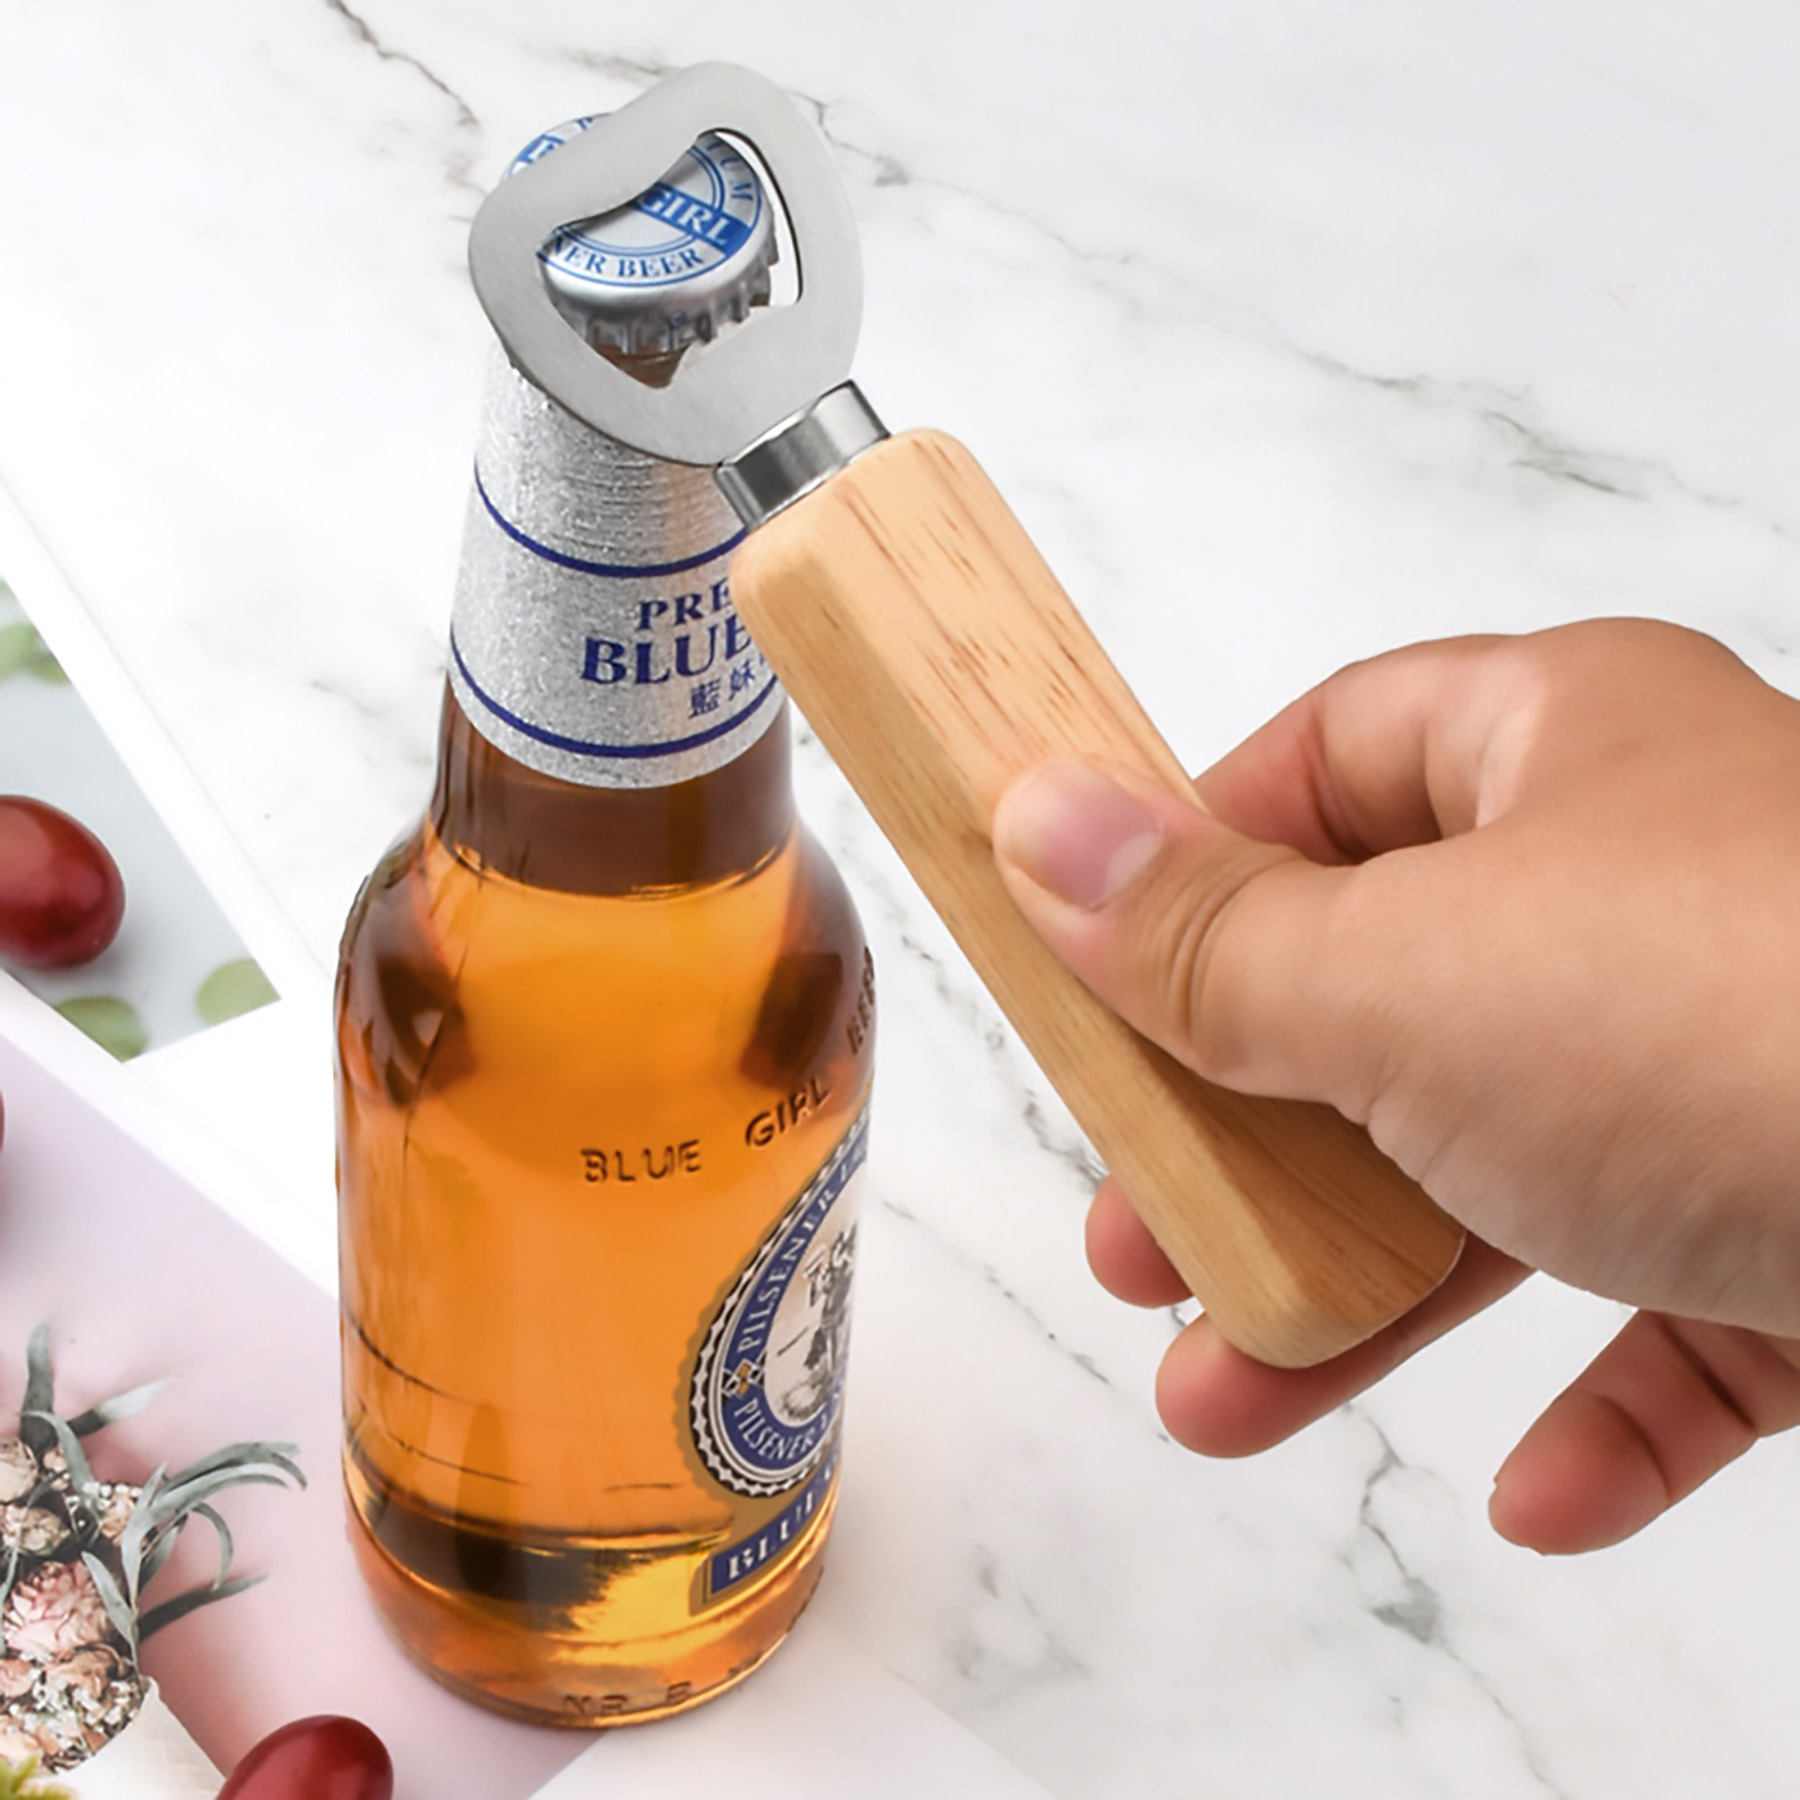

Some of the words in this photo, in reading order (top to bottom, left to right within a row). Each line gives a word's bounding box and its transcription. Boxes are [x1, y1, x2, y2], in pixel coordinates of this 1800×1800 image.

[638, 188, 729, 246] GIRL
[617, 247, 704, 278] BEER
[688, 652, 766, 719] 藍妹
[580, 1138, 702, 1183] BLUE
[744, 1075, 830, 1147] GIRL
[737, 1187, 835, 1354] PILSENER
[734, 1397, 816, 1460] PILSENER
